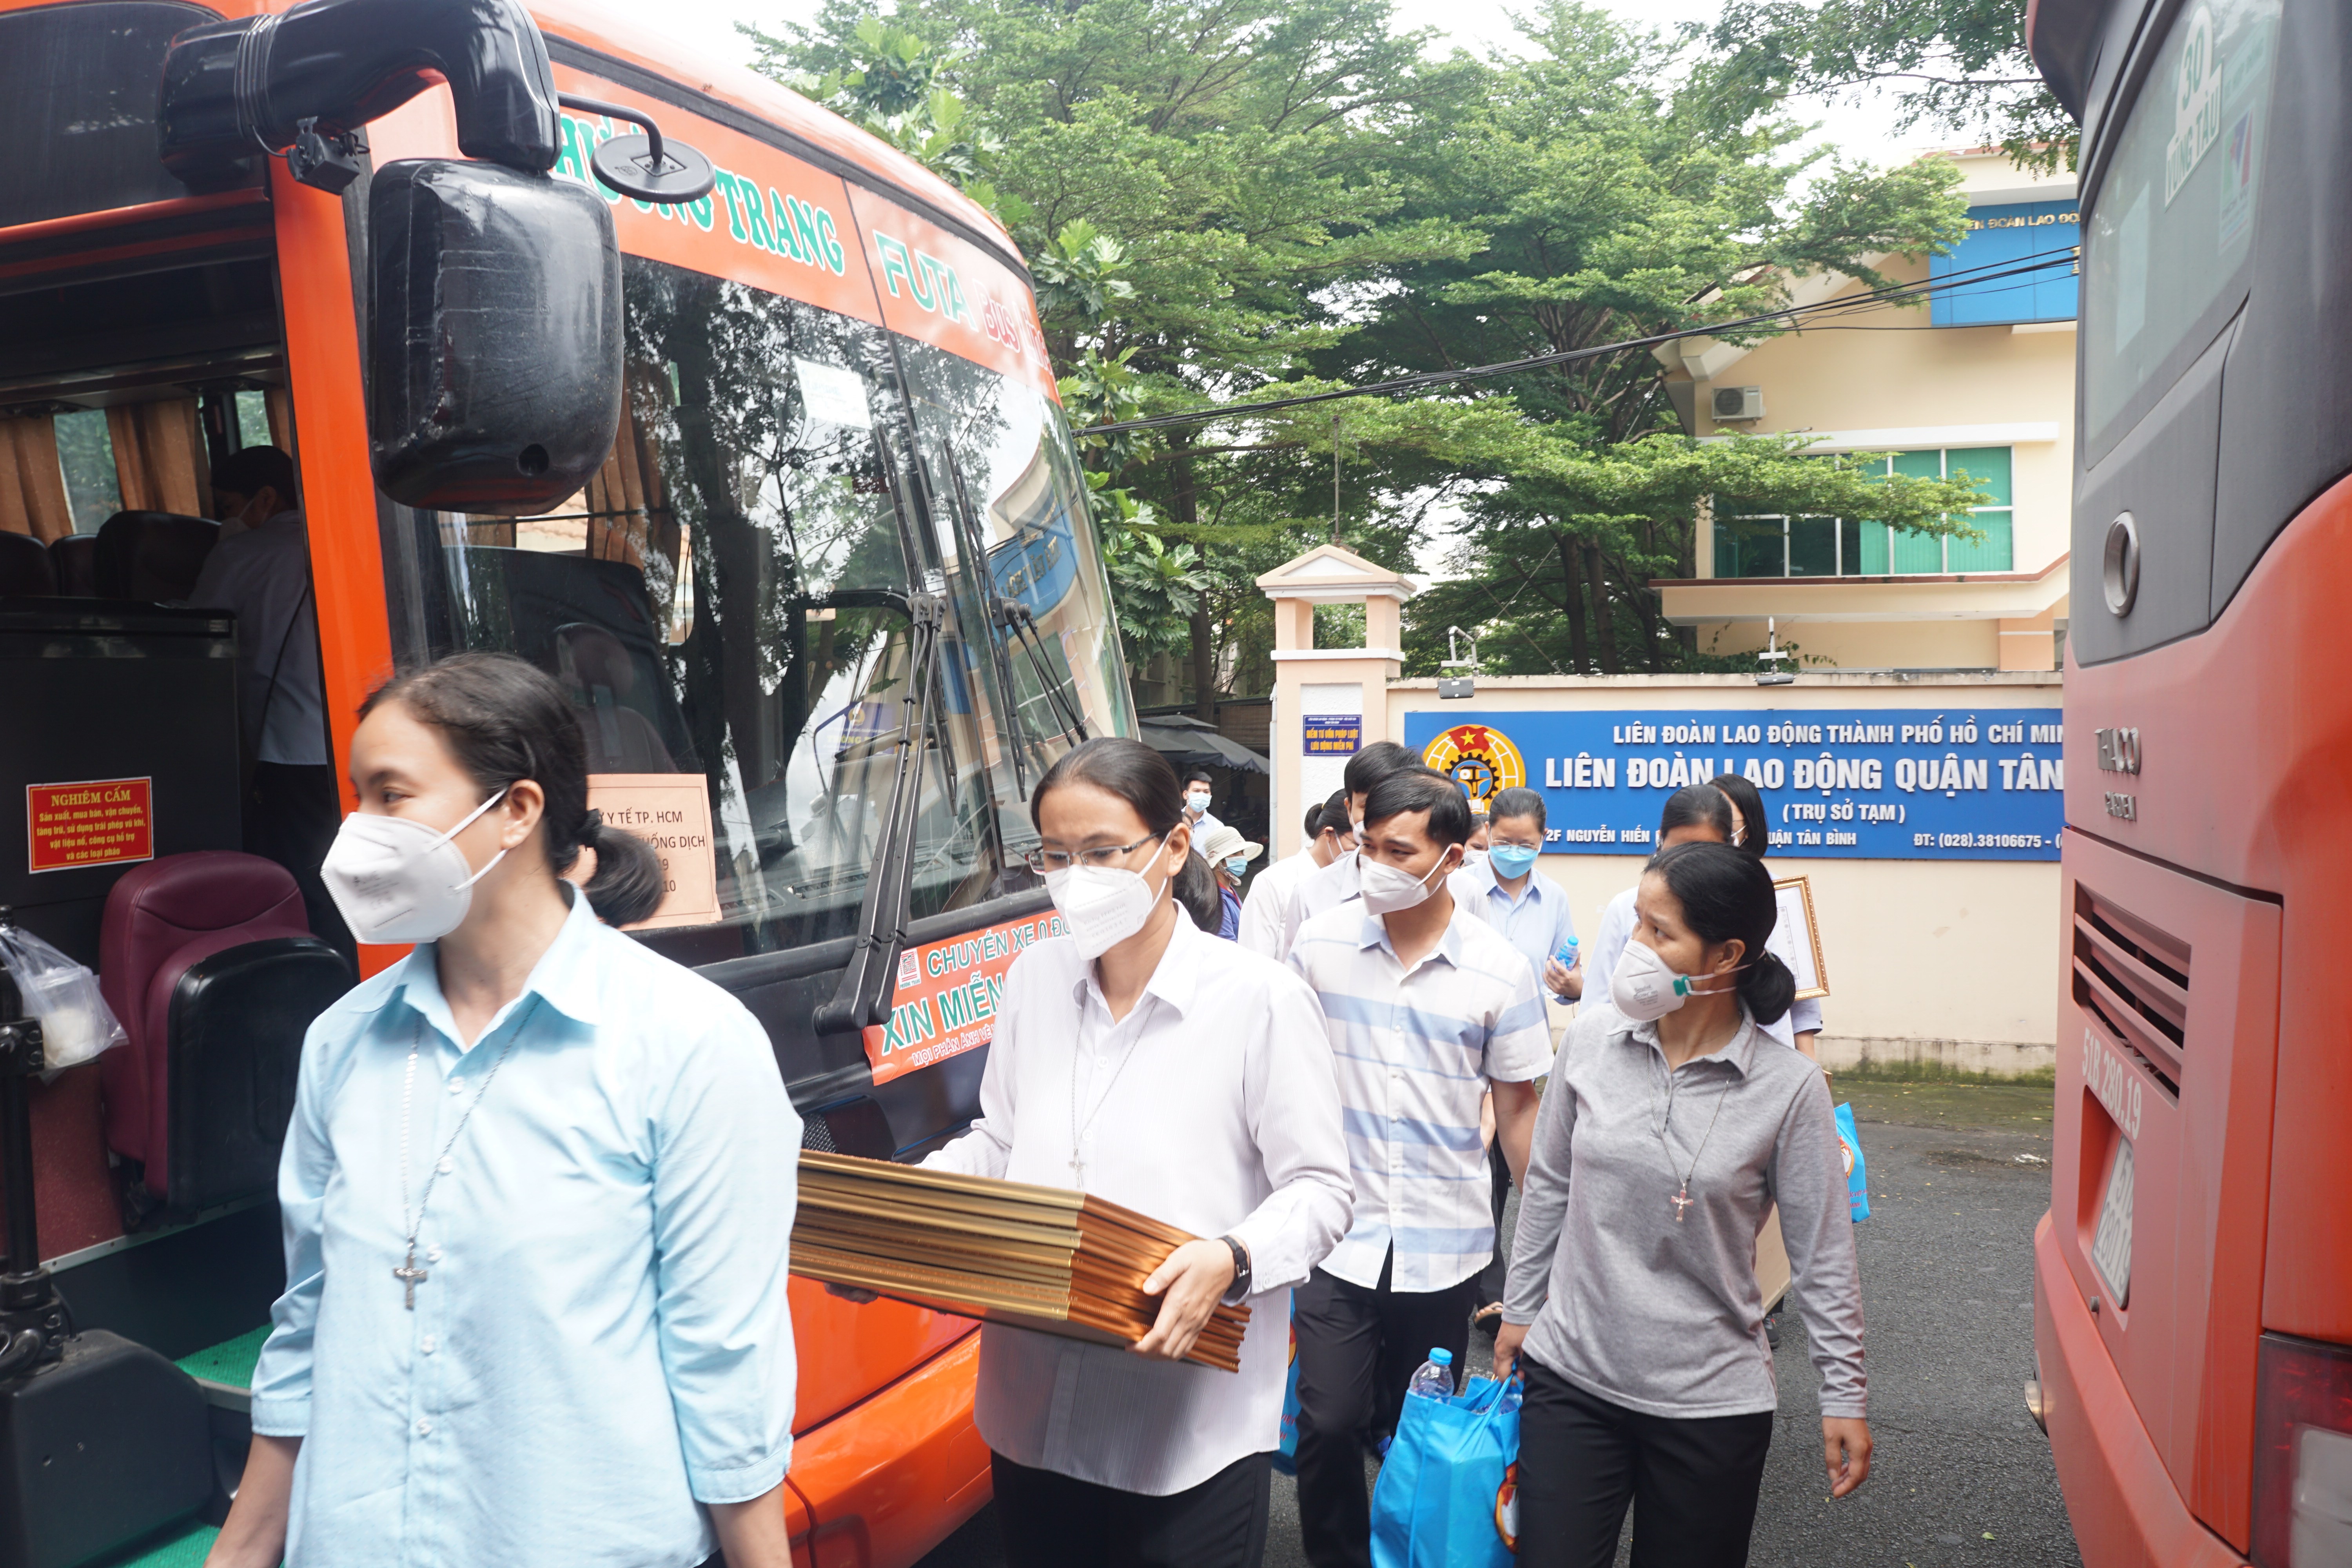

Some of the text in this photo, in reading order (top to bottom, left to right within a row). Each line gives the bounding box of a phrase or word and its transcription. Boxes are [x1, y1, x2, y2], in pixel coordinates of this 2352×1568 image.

[2182, 24, 2204, 111] 30
[713, 167, 845, 277] TRANG
[1987, 215, 2025, 229] ĐOÀN
[2028, 214, 2055, 226] LAO
[2058, 210, 2080, 226] ĐỘ
[873, 229, 979, 333] FUTA
[1613, 720, 1656, 744] LIÊN
[1662, 719, 1716, 744] ĐOÀN
[1722, 725, 1761, 744] LAO
[1767, 720, 1822, 748] ĐỘNG
[1826, 719, 1894, 744] THÀNH
[1901, 715, 1945, 744] PHỐ
[1950, 715, 1978, 744] HỒ
[1987, 720, 2024, 744] CHÍ
[1545, 751, 1615, 788] LIÊN
[1626, 751, 1714, 788] ĐOÀN
[1793, 751, 1882, 796] ĐỘNG
[1895, 753, 1988, 797] QUẬN
[1998, 752, 2064, 790] TÂN
[51, 786, 131, 807] NGHIÊM CẤM
[1830, 798, 1854, 820] SỞ
[73, 811, 87, 819] mua
[105, 807, 116, 818] vận
[607, 812, 614, 824] Y
[618, 807, 632, 824] TẾ
[635, 811, 653, 823] TP.
[657, 811, 683, 823] HCM
[77, 824, 93, 834] dụng
[680, 835, 705, 850] DỊCH
[1546, 829, 1561, 842] 2F
[1566, 824, 1615, 842] NGUYỄN
[1768, 829, 1792, 848] UẬN
[1796, 829, 1821, 845] TÂN
[1826, 829, 1857, 846] BÌNH
[1913, 833, 1935, 847] ĐT:
[76, 850, 88, 860] các
[927, 929, 1008, 978] CHUYẾN
[1012, 921, 1035, 952] XE
[880, 998, 935, 1057] XIN
[912, 1047, 933, 1067] MỌI
[933, 1038, 960, 1060] PHẢN
[960, 1032, 980, 1049] ẢNH
[2082, 1027, 2141, 1140] 51B 280.19
